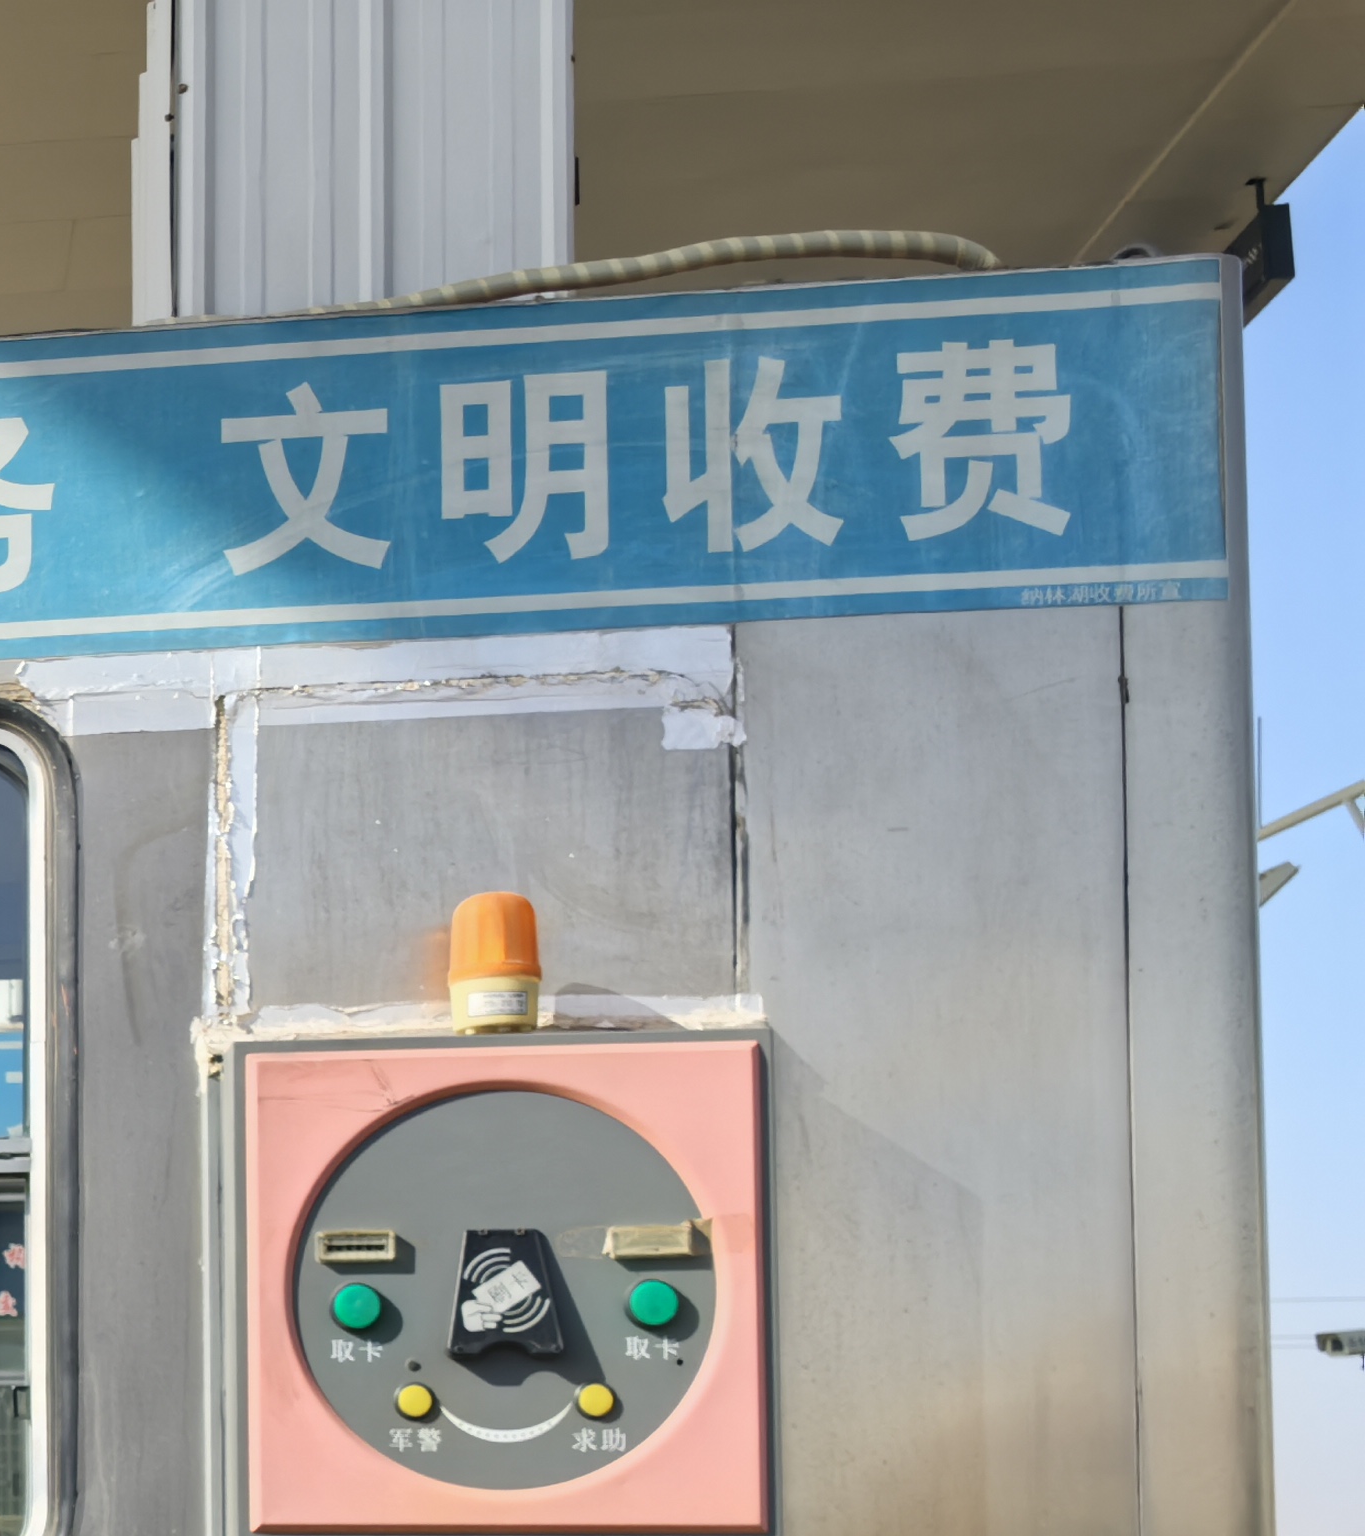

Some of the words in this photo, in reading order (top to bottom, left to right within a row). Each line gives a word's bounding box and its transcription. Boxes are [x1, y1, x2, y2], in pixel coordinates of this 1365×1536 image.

[220, 339, 1072, 576] 文明收费
[330, 1338, 384, 1363] 取卡
[625, 1335, 680, 1361] 取卡
[389, 1427, 443, 1453] 军警
[572, 1427, 627, 1453] 求助
